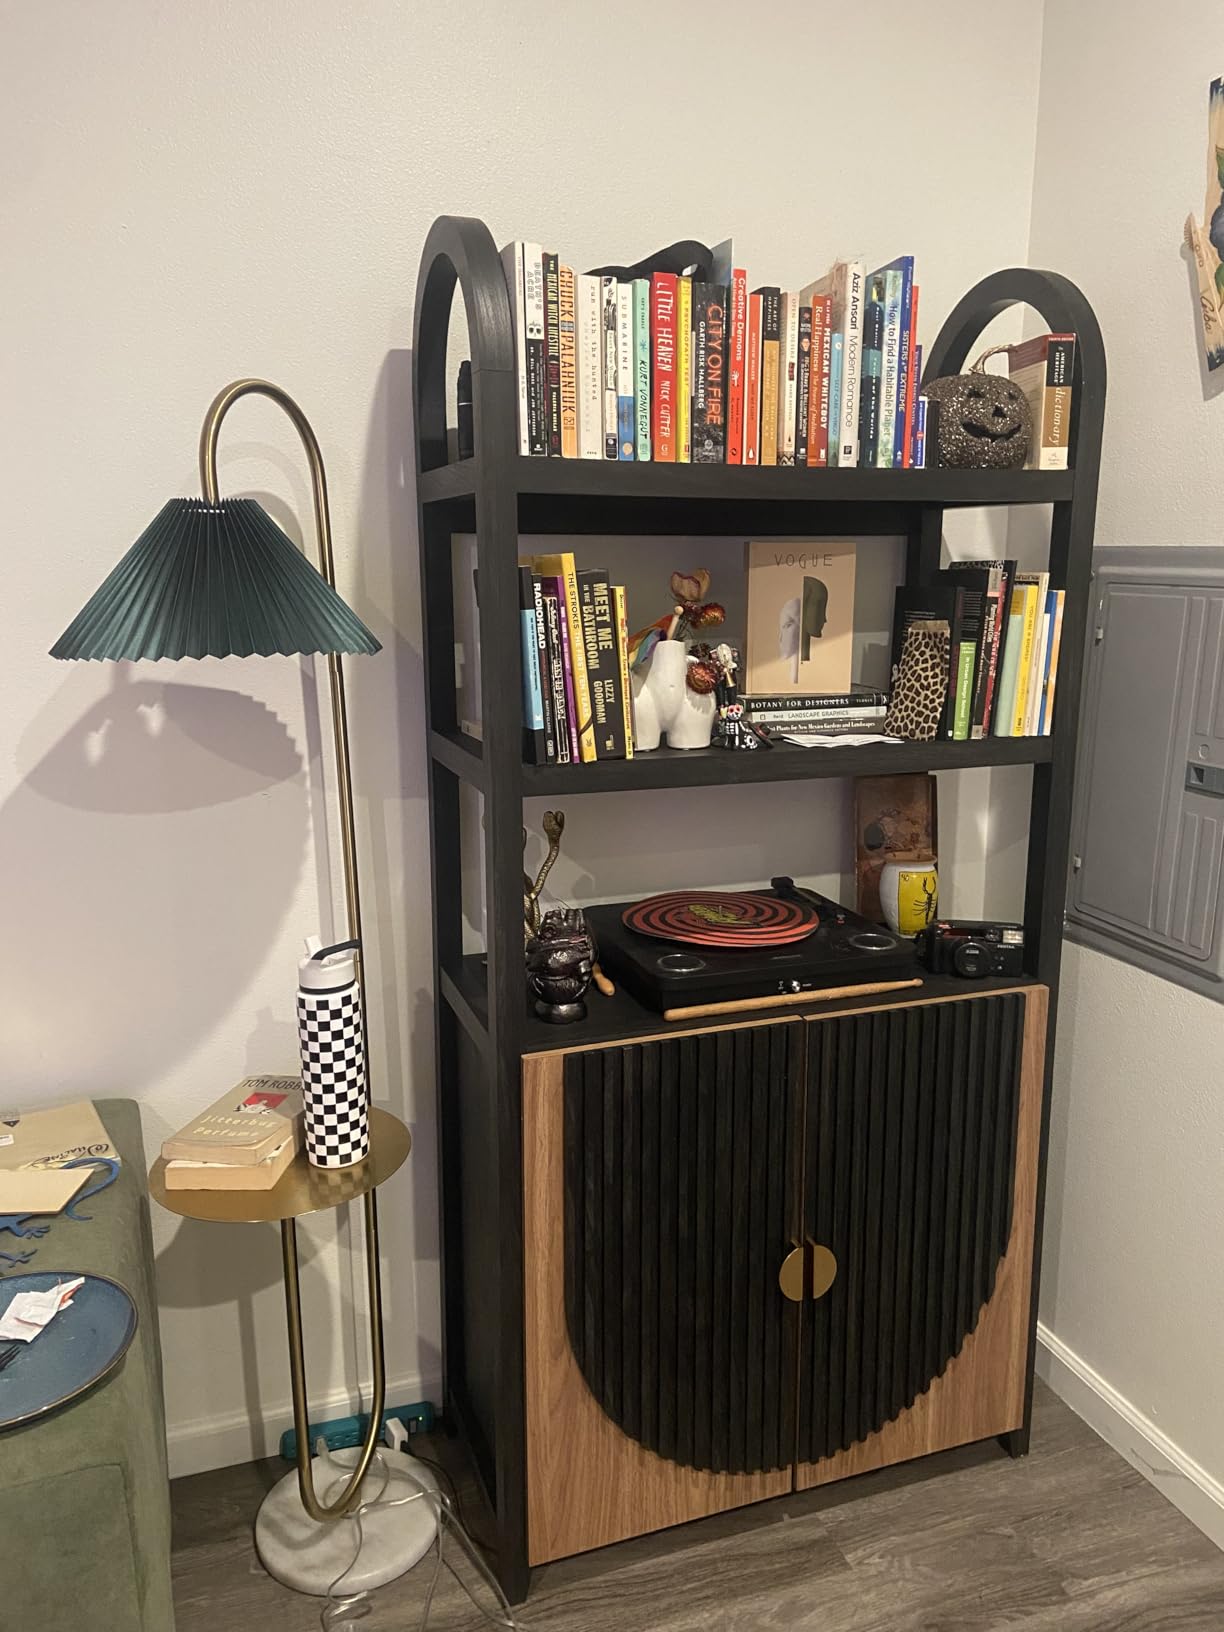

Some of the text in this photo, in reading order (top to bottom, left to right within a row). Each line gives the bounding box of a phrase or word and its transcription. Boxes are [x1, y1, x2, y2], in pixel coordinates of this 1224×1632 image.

[534, 262, 542, 310] DEATH'S
[547, 274, 558, 301] MEXICAN
[548, 304, 558, 324] WITCH
[656, 282, 674, 371] LITTLE HEAVEN
[773, 323, 777, 331] OF
[791, 322, 795, 331] TO
[888, 327, 896, 336] to
[889, 306, 898, 325] How
[1200, 296, 1217, 333] Cuba
[548, 326, 559, 356] LIFESTYLE
[560, 270, 575, 413] CHUCK PALAHNIUK
[812, 327, 822, 371] Happiness
[822, 328, 830, 373] MEXICAN
[846, 272, 860, 427] Aziz Ansari Modern Romance
[888, 338, 896, 356] Find
[707, 304, 723, 425] CITY ON FIRE
[639, 360, 648, 439] KURT VONNEGUT
[820, 377, 829, 429] WHITEBOY
[885, 366, 895, 408] Habitable
[898, 372, 906, 412] EXTREME
[659, 380, 671, 437] NICK CUTTER
[884, 409, 892, 436] Planet
[1049, 388, 1066, 446] dictionary
[775, 553, 833, 569] VOGUE
[534, 583, 546, 649] RADIOHEAD
[570, 591, 580, 629] STROKES
[593, 583, 613, 650] MEET ME
[989, 604, 997, 622] Planning
[582, 605, 600, 670] BATHROOM
[593, 680, 606, 724] GOODMAN
[604, 679, 615, 703] LIZZY
[806, 698, 849, 706] DESIGNERS
[193, 1127, 259, 1136] Perfume
[200, 1115, 278, 1128] Jitterbug
